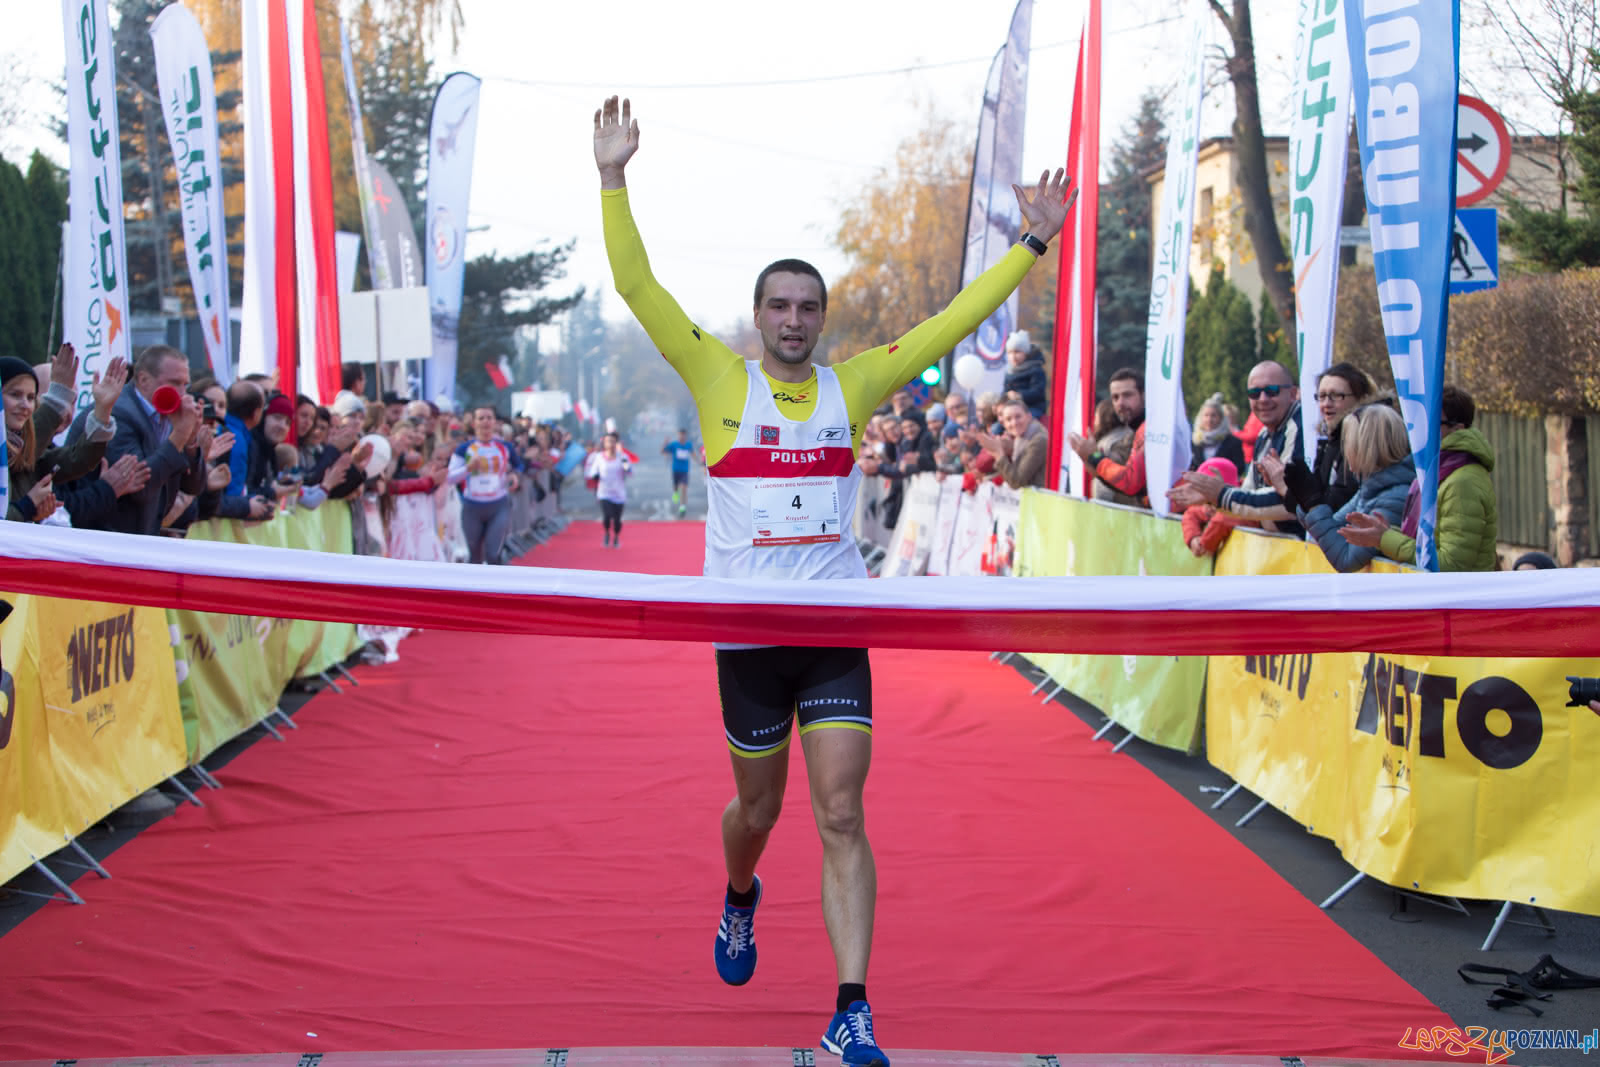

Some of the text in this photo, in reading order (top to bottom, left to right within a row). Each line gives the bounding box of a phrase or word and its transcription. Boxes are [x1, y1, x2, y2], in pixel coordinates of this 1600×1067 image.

[723, 418, 741, 428] KON
[770, 450, 826, 464] POLSKA
[791, 495, 802, 509] 4
[67, 608, 135, 704] NETTO
[1356, 652, 1543, 770] NETTO
